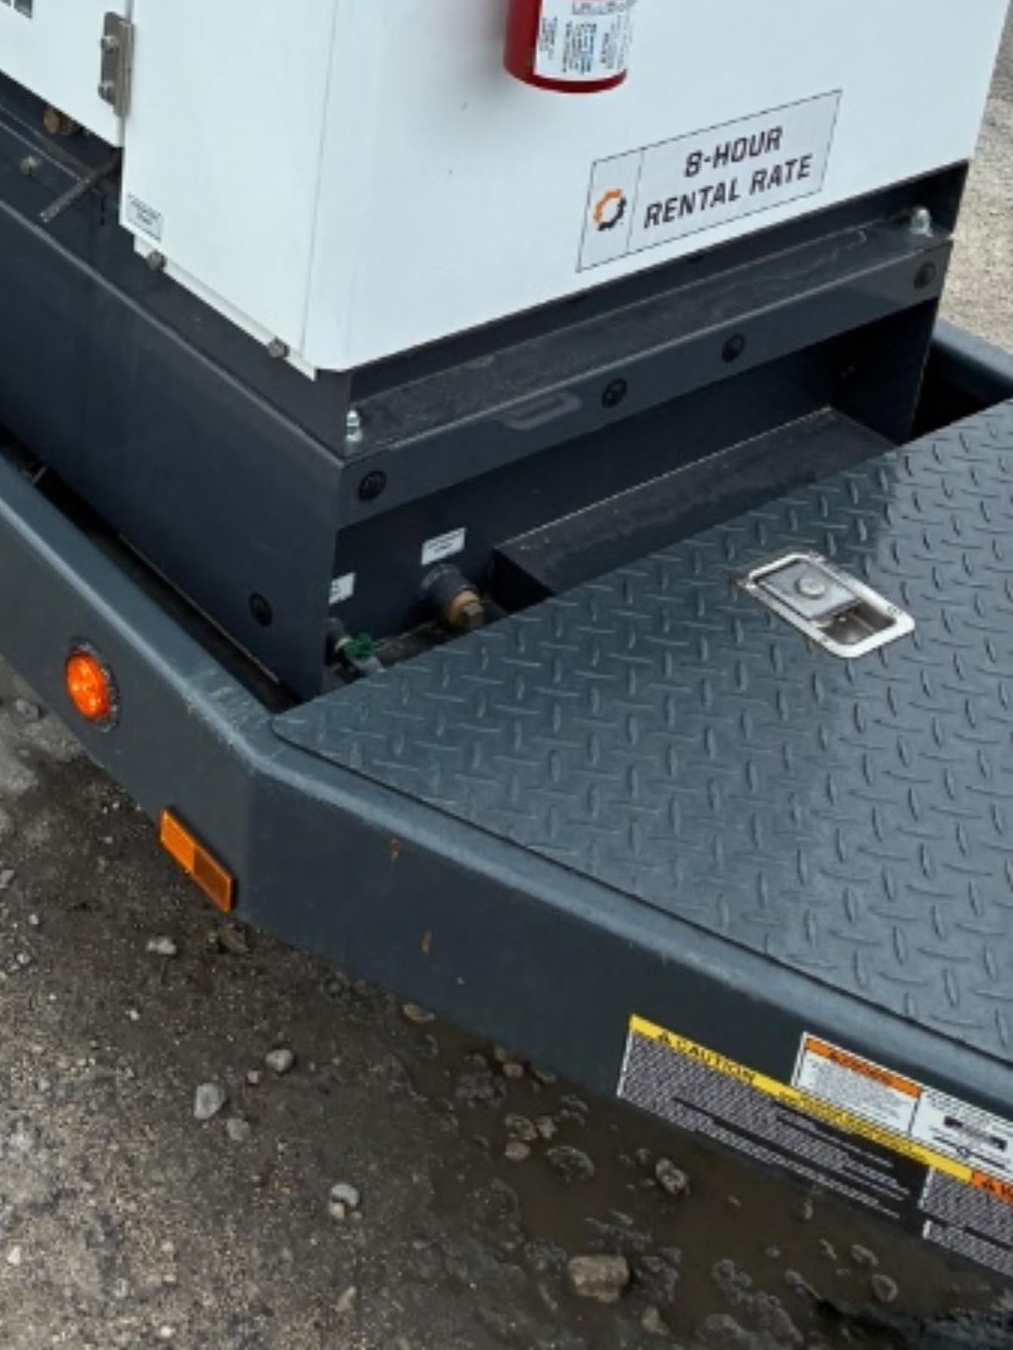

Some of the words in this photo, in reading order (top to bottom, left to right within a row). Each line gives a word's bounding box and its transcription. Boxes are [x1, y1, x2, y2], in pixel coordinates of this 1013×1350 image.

[684, 126, 783, 178] 8-HOUR
[644, 179, 740, 228] RENTAL
[750, 154, 812, 195] RATE
